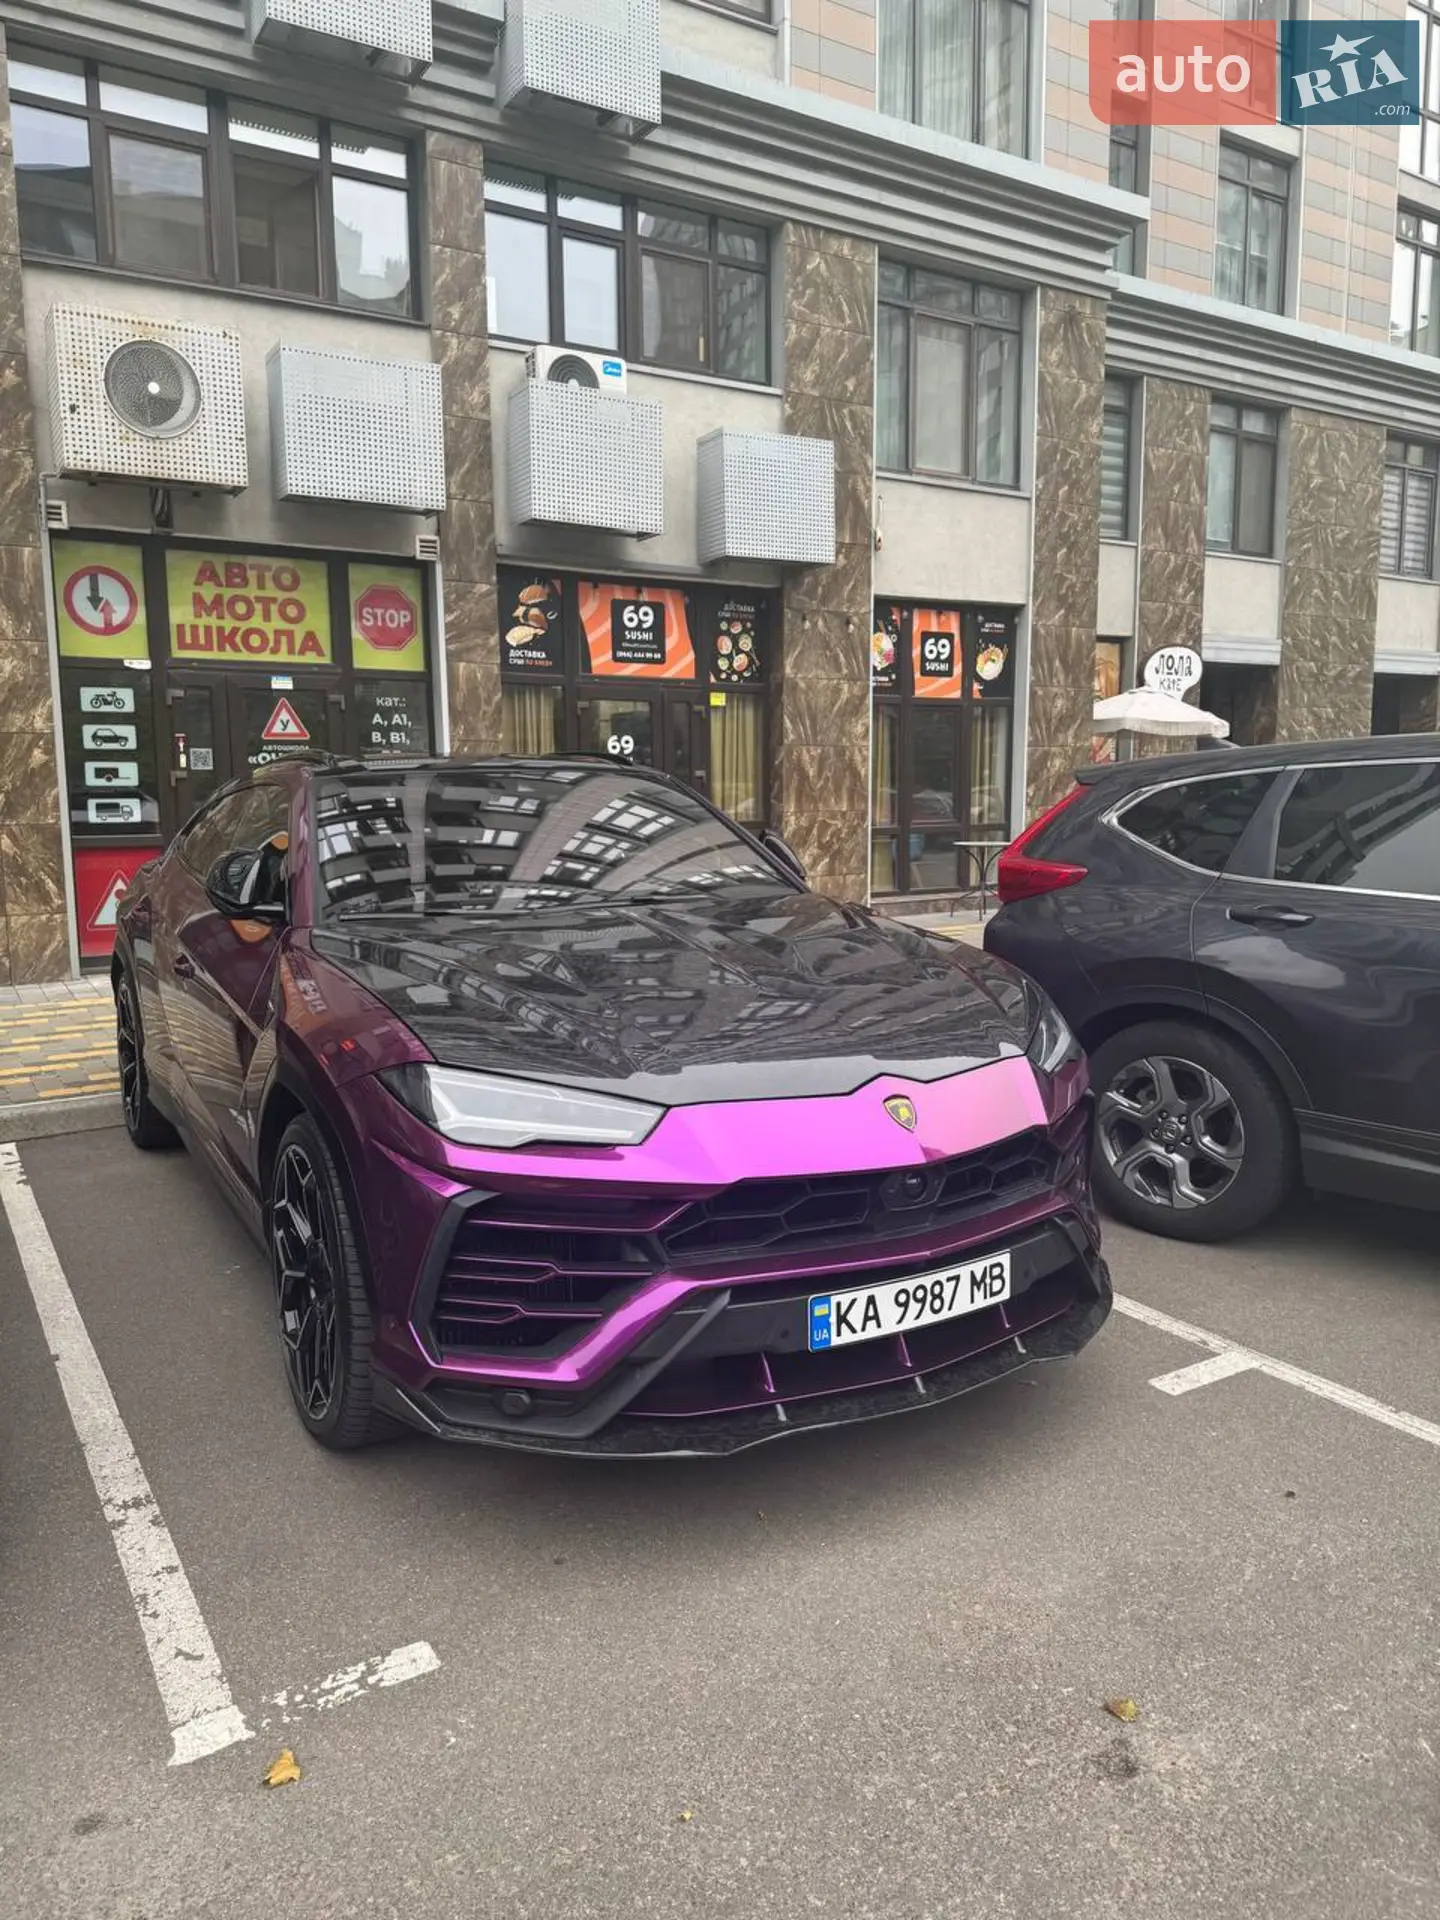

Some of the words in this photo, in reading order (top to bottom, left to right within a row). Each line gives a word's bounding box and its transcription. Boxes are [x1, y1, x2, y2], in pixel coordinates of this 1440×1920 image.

[193, 560, 301, 592] АВТО
[192, 592, 307, 625] МОТО
[362, 607, 412, 628] STOP
[623, 605, 655, 628] 69
[175, 623, 326, 657] ШКОЛА
[624, 630, 654, 641] SUSHI
[924, 637, 951, 660] 69
[925, 661, 949, 672] SUSHI
[607, 734, 635, 755] 69
[813, 1331, 829, 1342] UA
[835, 1294, 882, 1338] KA
[894, 1274, 961, 1326] 9987
[969, 1261, 1006, 1305] MB
